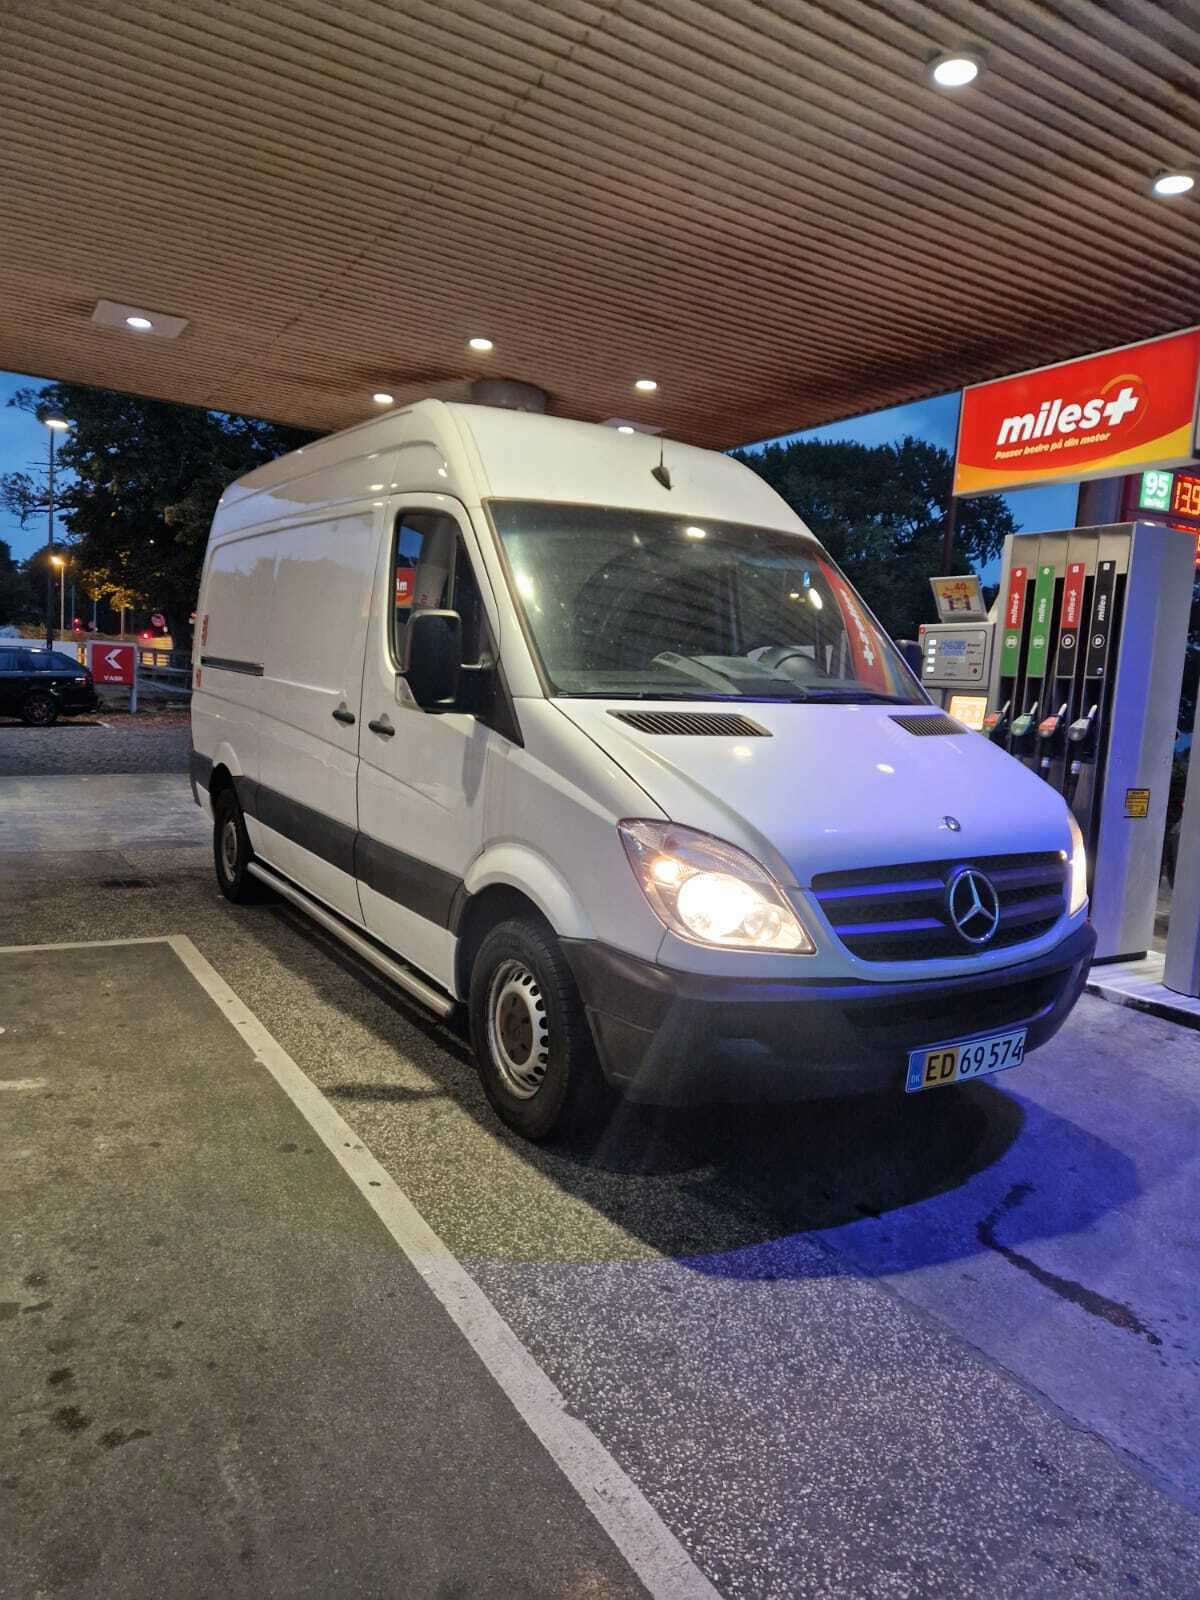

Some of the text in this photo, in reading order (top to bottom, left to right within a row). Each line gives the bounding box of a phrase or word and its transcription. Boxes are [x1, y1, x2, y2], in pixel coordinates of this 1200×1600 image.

[1023, 443, 1050, 456] bedre
[1049, 439, 1064, 452] på
[1063, 436, 1079, 448] din
[1079, 432, 1112, 445] motor
[1145, 472, 1168, 497] 95
[1038, 597, 1048, 624] miles
[1097, 594, 1107, 622] miles
[925, 1054, 955, 1081] ED
